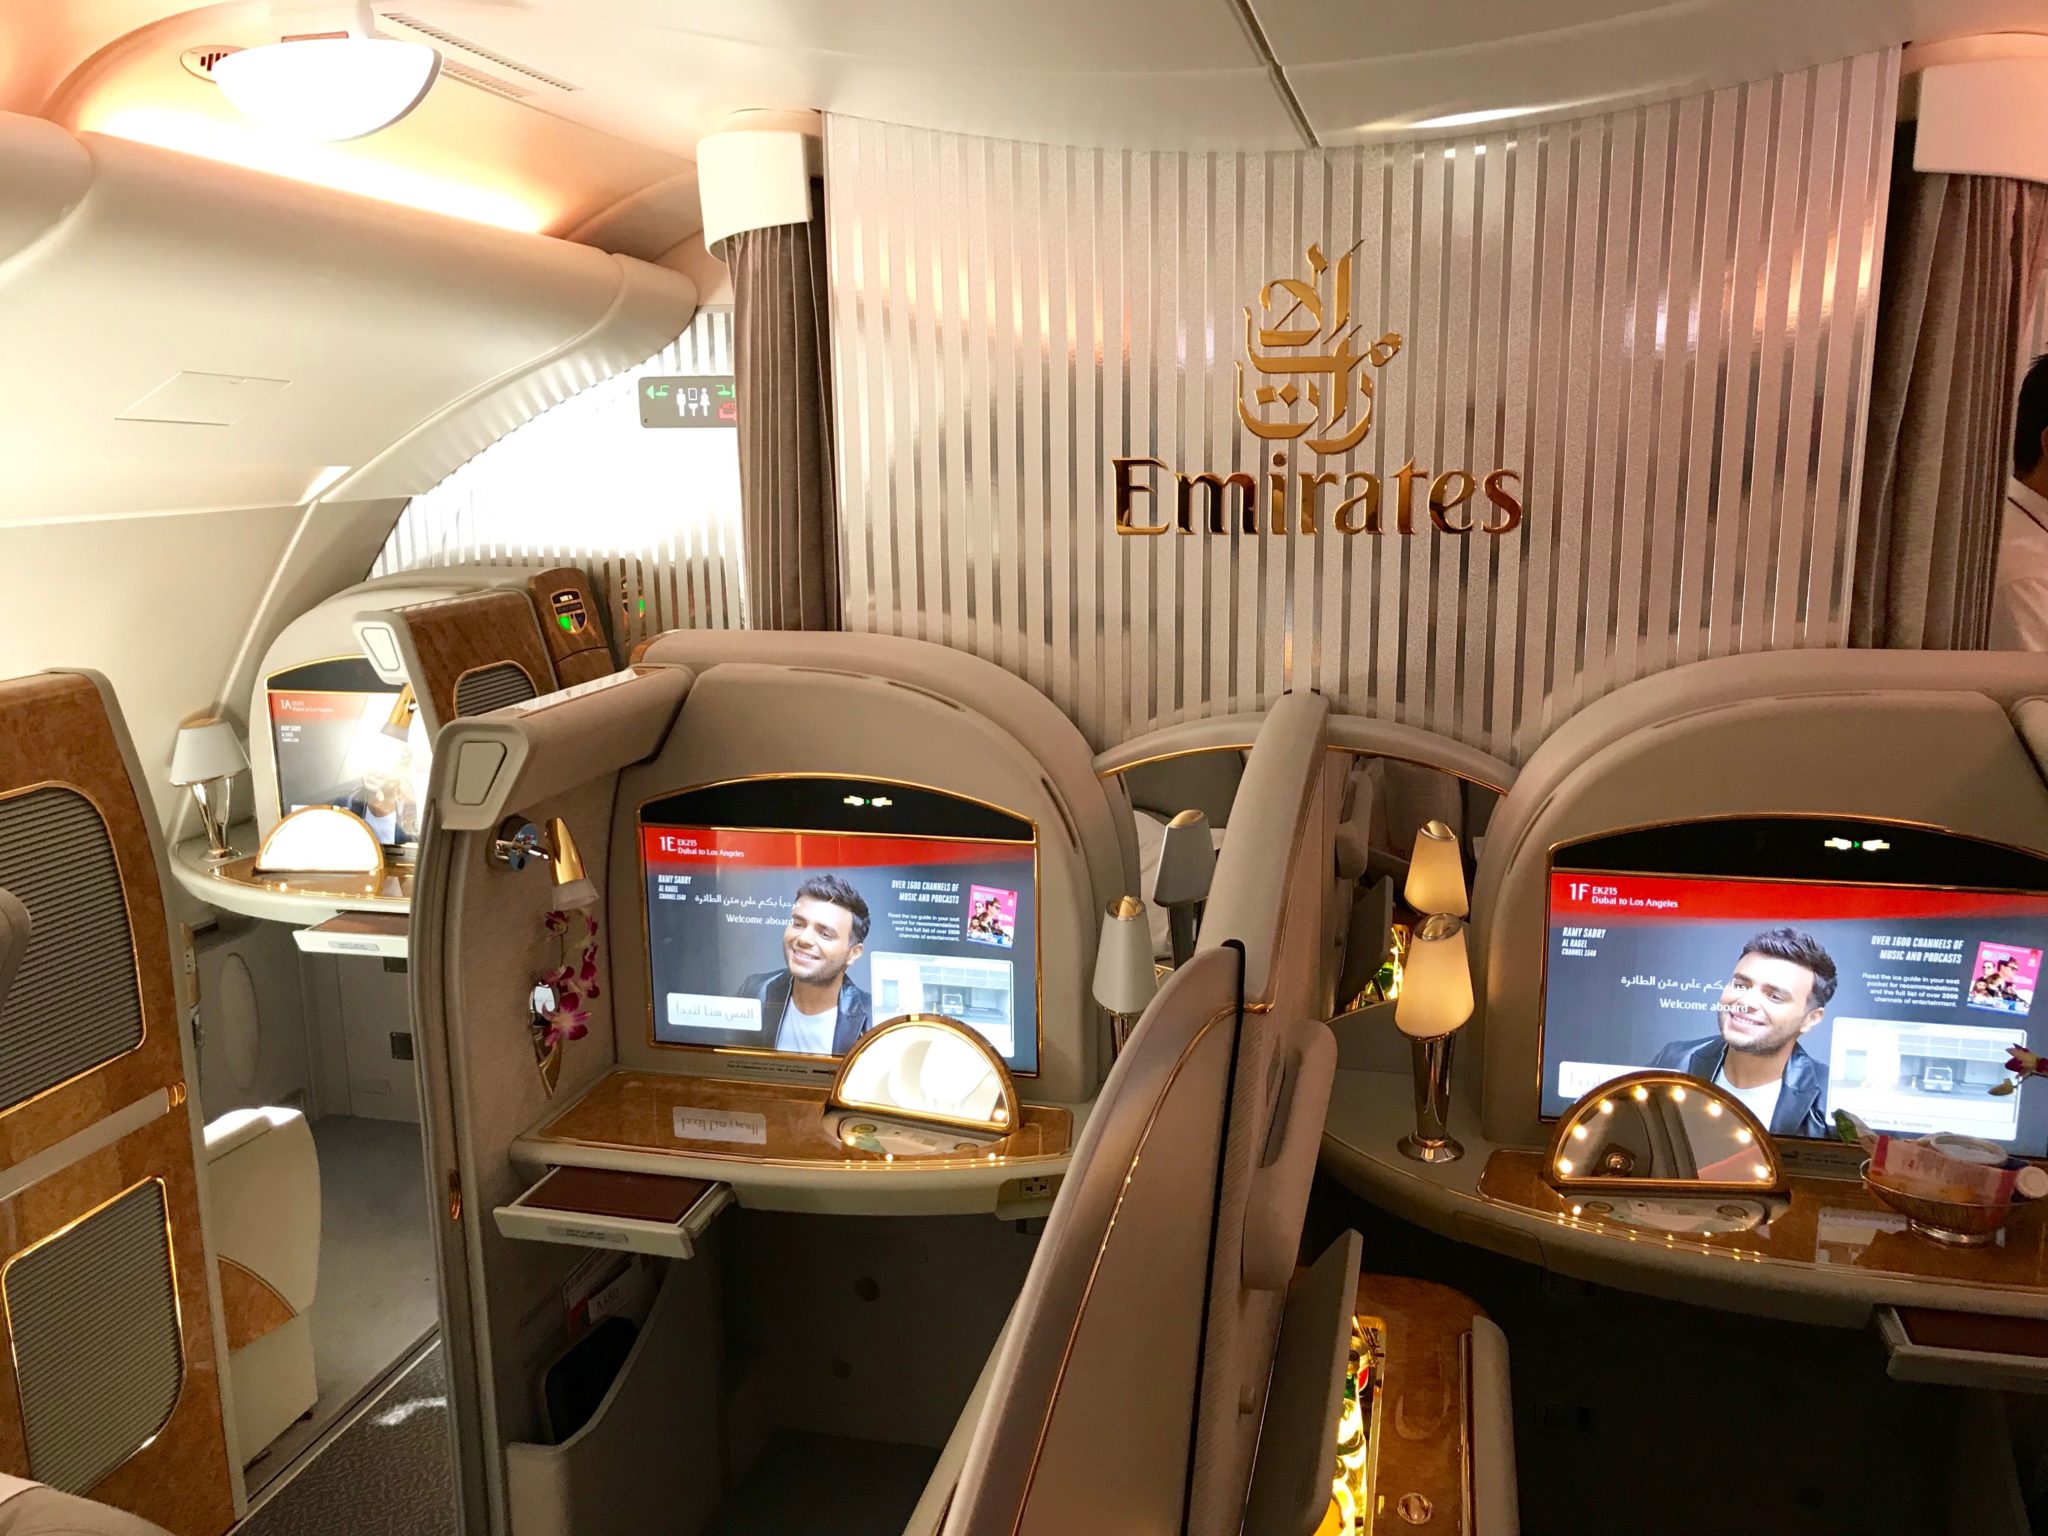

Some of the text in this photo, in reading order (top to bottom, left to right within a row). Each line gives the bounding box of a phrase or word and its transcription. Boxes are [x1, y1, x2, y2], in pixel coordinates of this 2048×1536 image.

[1111, 453, 1523, 536] Emirates
[280, 699, 292, 710] 1A
[659, 836, 676, 851] 1E
[677, 839, 697, 847] EK215
[678, 847, 744, 858] Dubai to Los Angeles
[891, 880, 906, 889] OVER
[922, 882, 951, 892] CHANNELS
[951, 883, 960, 892] OF
[1569, 883, 1590, 901] 1F
[1592, 887, 1618, 895] EK215
[899, 892, 960, 904] MUSIC AND PODCASTS
[1591, 896, 1679, 909] Dubai to Los Angeles
[725, 914, 793, 926] Welcome aboard
[1562, 927, 1607, 939] RAMY SABRY
[1562, 939, 1587, 948] AL RAGEL
[1871, 935, 1890, 946] OVER
[1912, 937, 1951, 950] CHANNELS
[1953, 939, 1964, 950] OF
[1561, 948, 1583, 957] CHANNEL
[1879, 949, 1962, 964] MUSIC AND PODCASTS
[1621, 975, 1655, 986] الطائرة
[1658, 978, 1678, 989] متن
[1680, 977, 1701, 991] على
[1903, 975, 1921, 983] guide
[1899, 983, 1959, 992] recommendations
[1659, 998, 1748, 1013] Welcome aboard
[1874, 996, 1903, 1004] channels
[1911, 998, 1957, 1008] entertainment.
